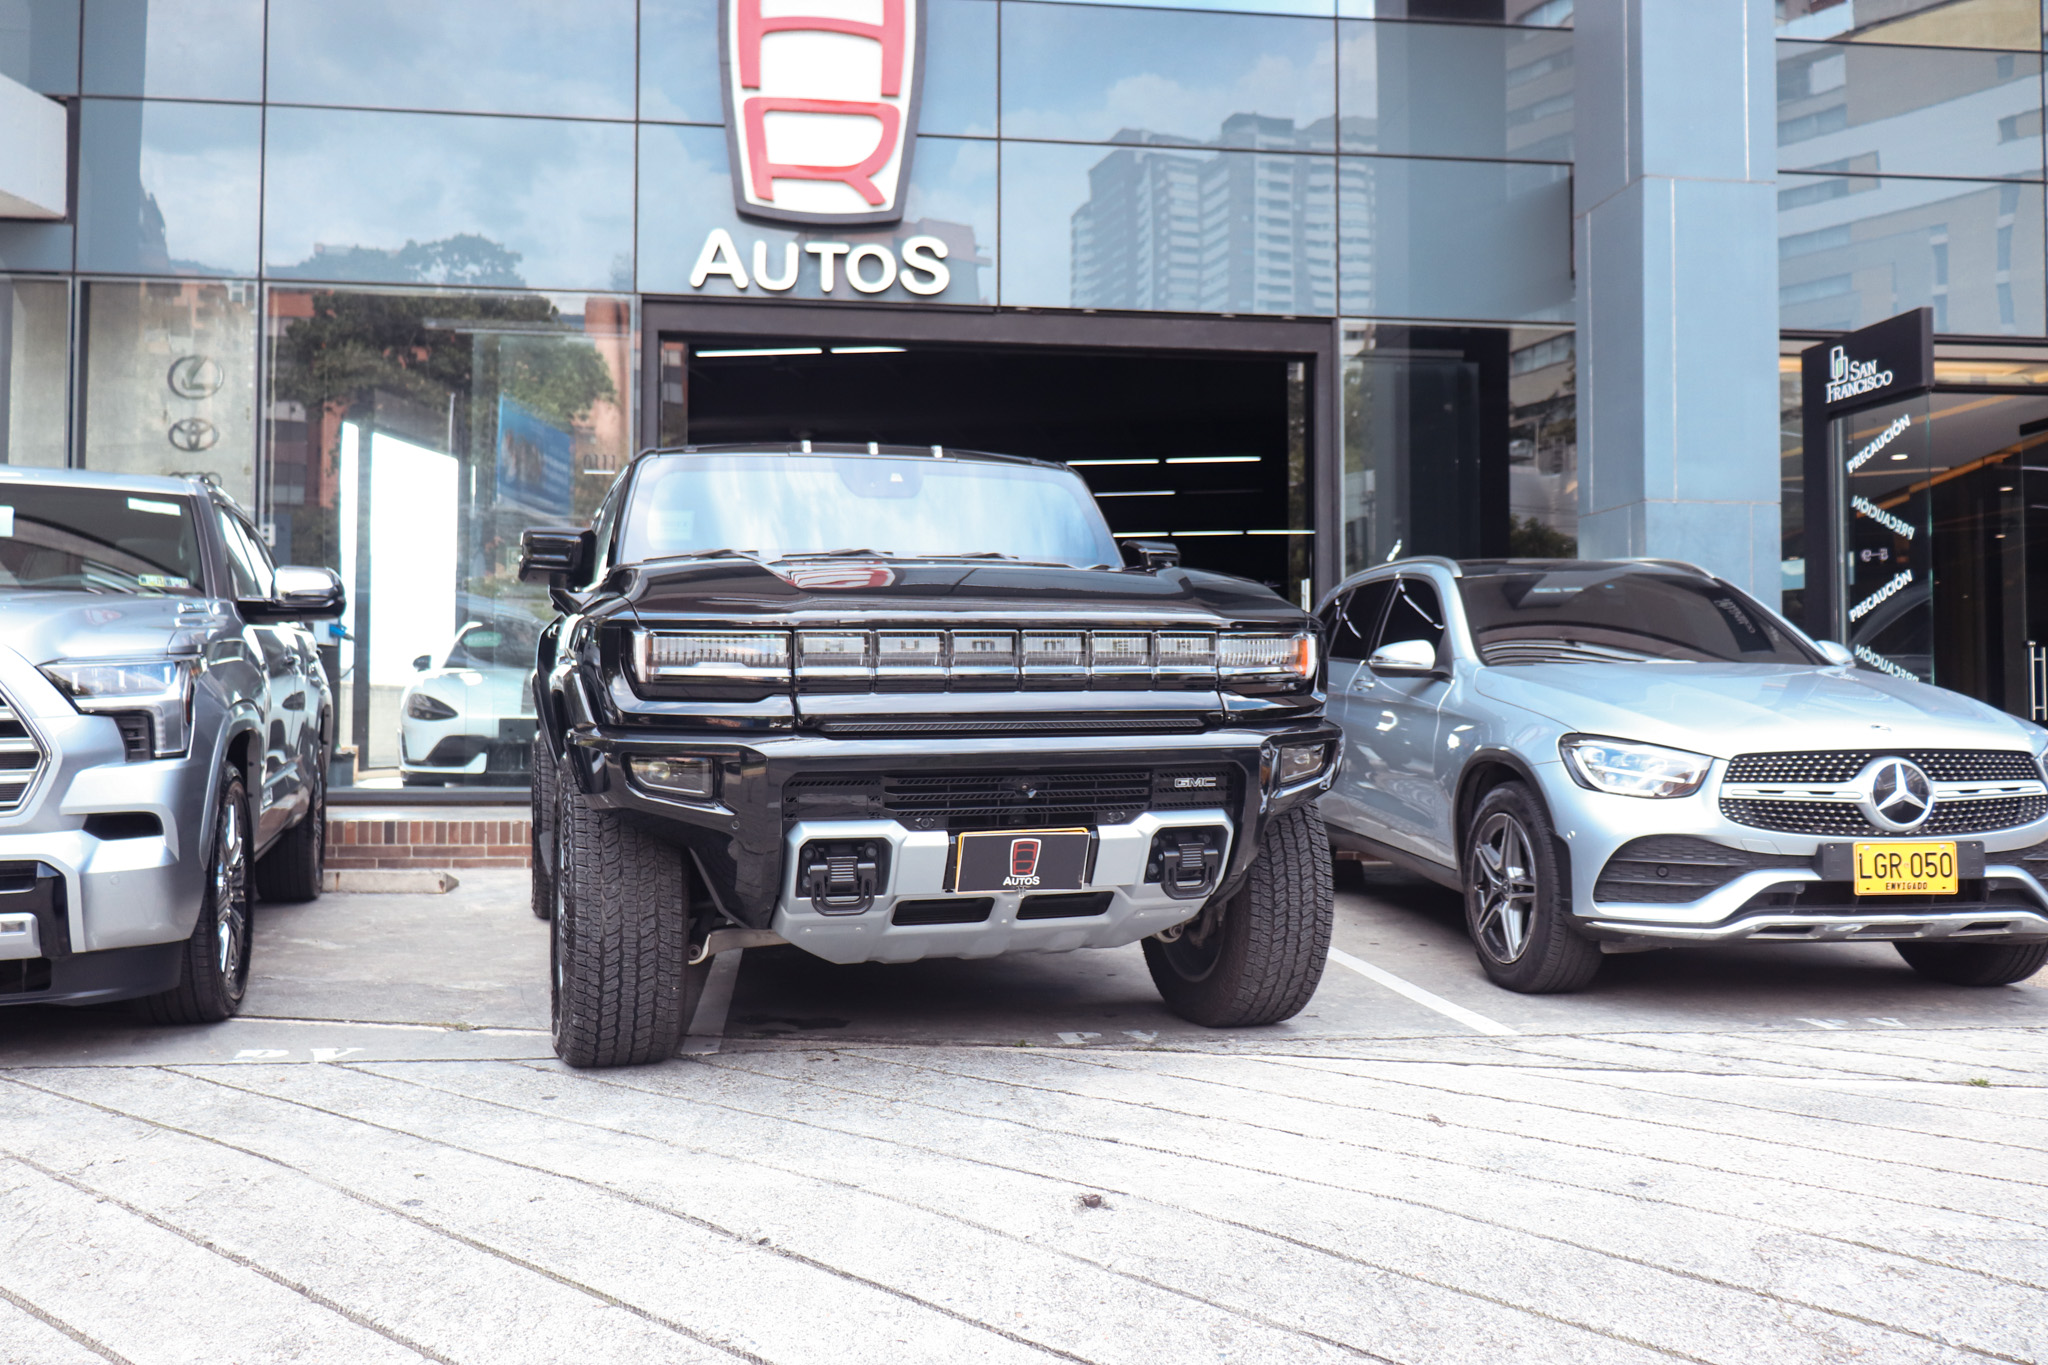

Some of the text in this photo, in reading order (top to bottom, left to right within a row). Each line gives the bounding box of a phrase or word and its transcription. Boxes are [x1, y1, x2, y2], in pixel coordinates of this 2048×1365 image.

[689, 228, 950, 296] AUTOS
[1849, 359, 1878, 381] SAN
[1826, 370, 1893, 403] FRANCISCO
[1846, 413, 1911, 473] PRECAUCIÓN
[1848, 569, 1913, 622] PRECAUCIÓN
[1174, 776, 1217, 788] GMC
[1859, 852, 1953, 879] LGR 050
[1002, 876, 1040, 886] AUTOS
[1886, 882, 1928, 890] ENVIGADO
